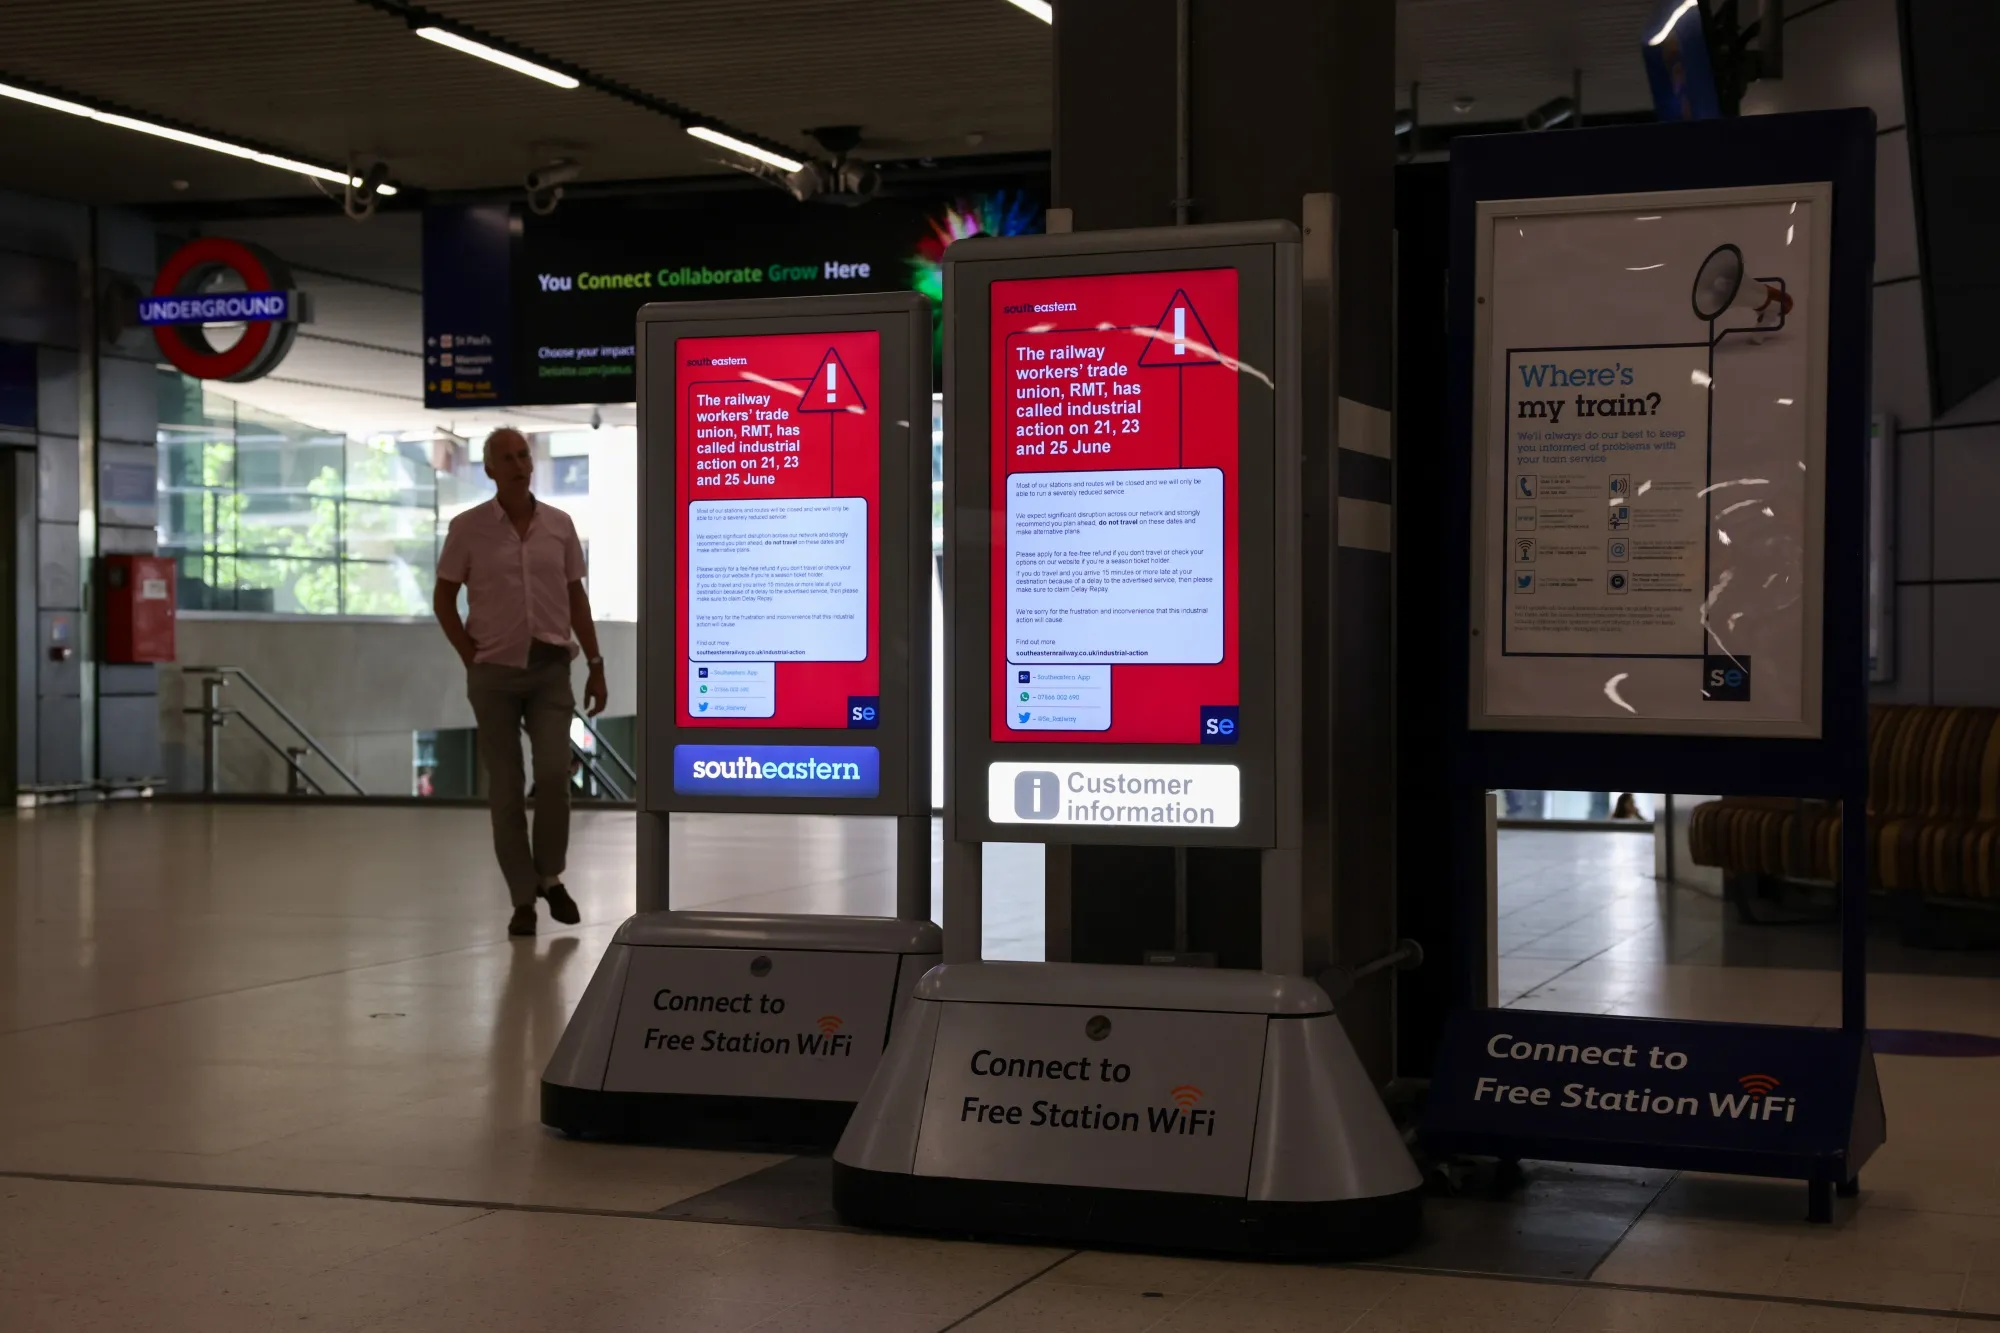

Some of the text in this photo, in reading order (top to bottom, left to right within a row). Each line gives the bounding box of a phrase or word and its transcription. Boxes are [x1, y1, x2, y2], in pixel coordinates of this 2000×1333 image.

[538, 261, 870, 292] You Connect Collaborate Grow Here
[139, 296, 284, 320] UNDERGROUND
[1004, 302, 1077, 314] southeastern
[538, 344, 635, 360] Choose your impact
[1016, 345, 1105, 361] The railway
[687, 357, 748, 366] southeastern
[1087, 363, 1128, 376] trade
[1519, 363, 1633, 387] Where's
[1017, 382, 1141, 399] union, RMT, has
[697, 393, 770, 407] The railway
[1518, 392, 1661, 424] my train?
[756, 408, 789, 420] trade
[1016, 400, 1141, 417] called industrial
[697, 424, 800, 438] union, RMT, has
[1016, 419, 1140, 436] action on 21, 23
[1545, 431, 1581, 441] always
[1660, 430, 1685, 439] keep
[697, 440, 800, 454] called industrial
[1016, 440, 1111, 455] and 25 June
[1517, 444, 1536, 453] you
[1540, 443, 1586, 452] informed
[1603, 442, 1650, 452] problems
[697, 456, 798, 470] action on 21, 23
[1517, 456, 1540, 465] your
[1543, 455, 1567, 463] train
[697, 473, 775, 486] and 25 June
[1711, 669, 1743, 687] se
[853, 707, 874, 720] se
[1207, 718, 1233, 734] se
[694, 757, 860, 779] southeastern
[1068, 772, 1193, 795] Customer
[1068, 800, 1214, 824] information
[654, 988, 785, 1014] Connect to
[644, 1029, 853, 1056] Free Station WiFi
[1487, 1034, 1688, 1070] Connect to
[970, 1050, 1130, 1082] Connect to
[1474, 1077, 1796, 1122] Free Station WiFi
[961, 1098, 1216, 1137] Free Station WiFi
